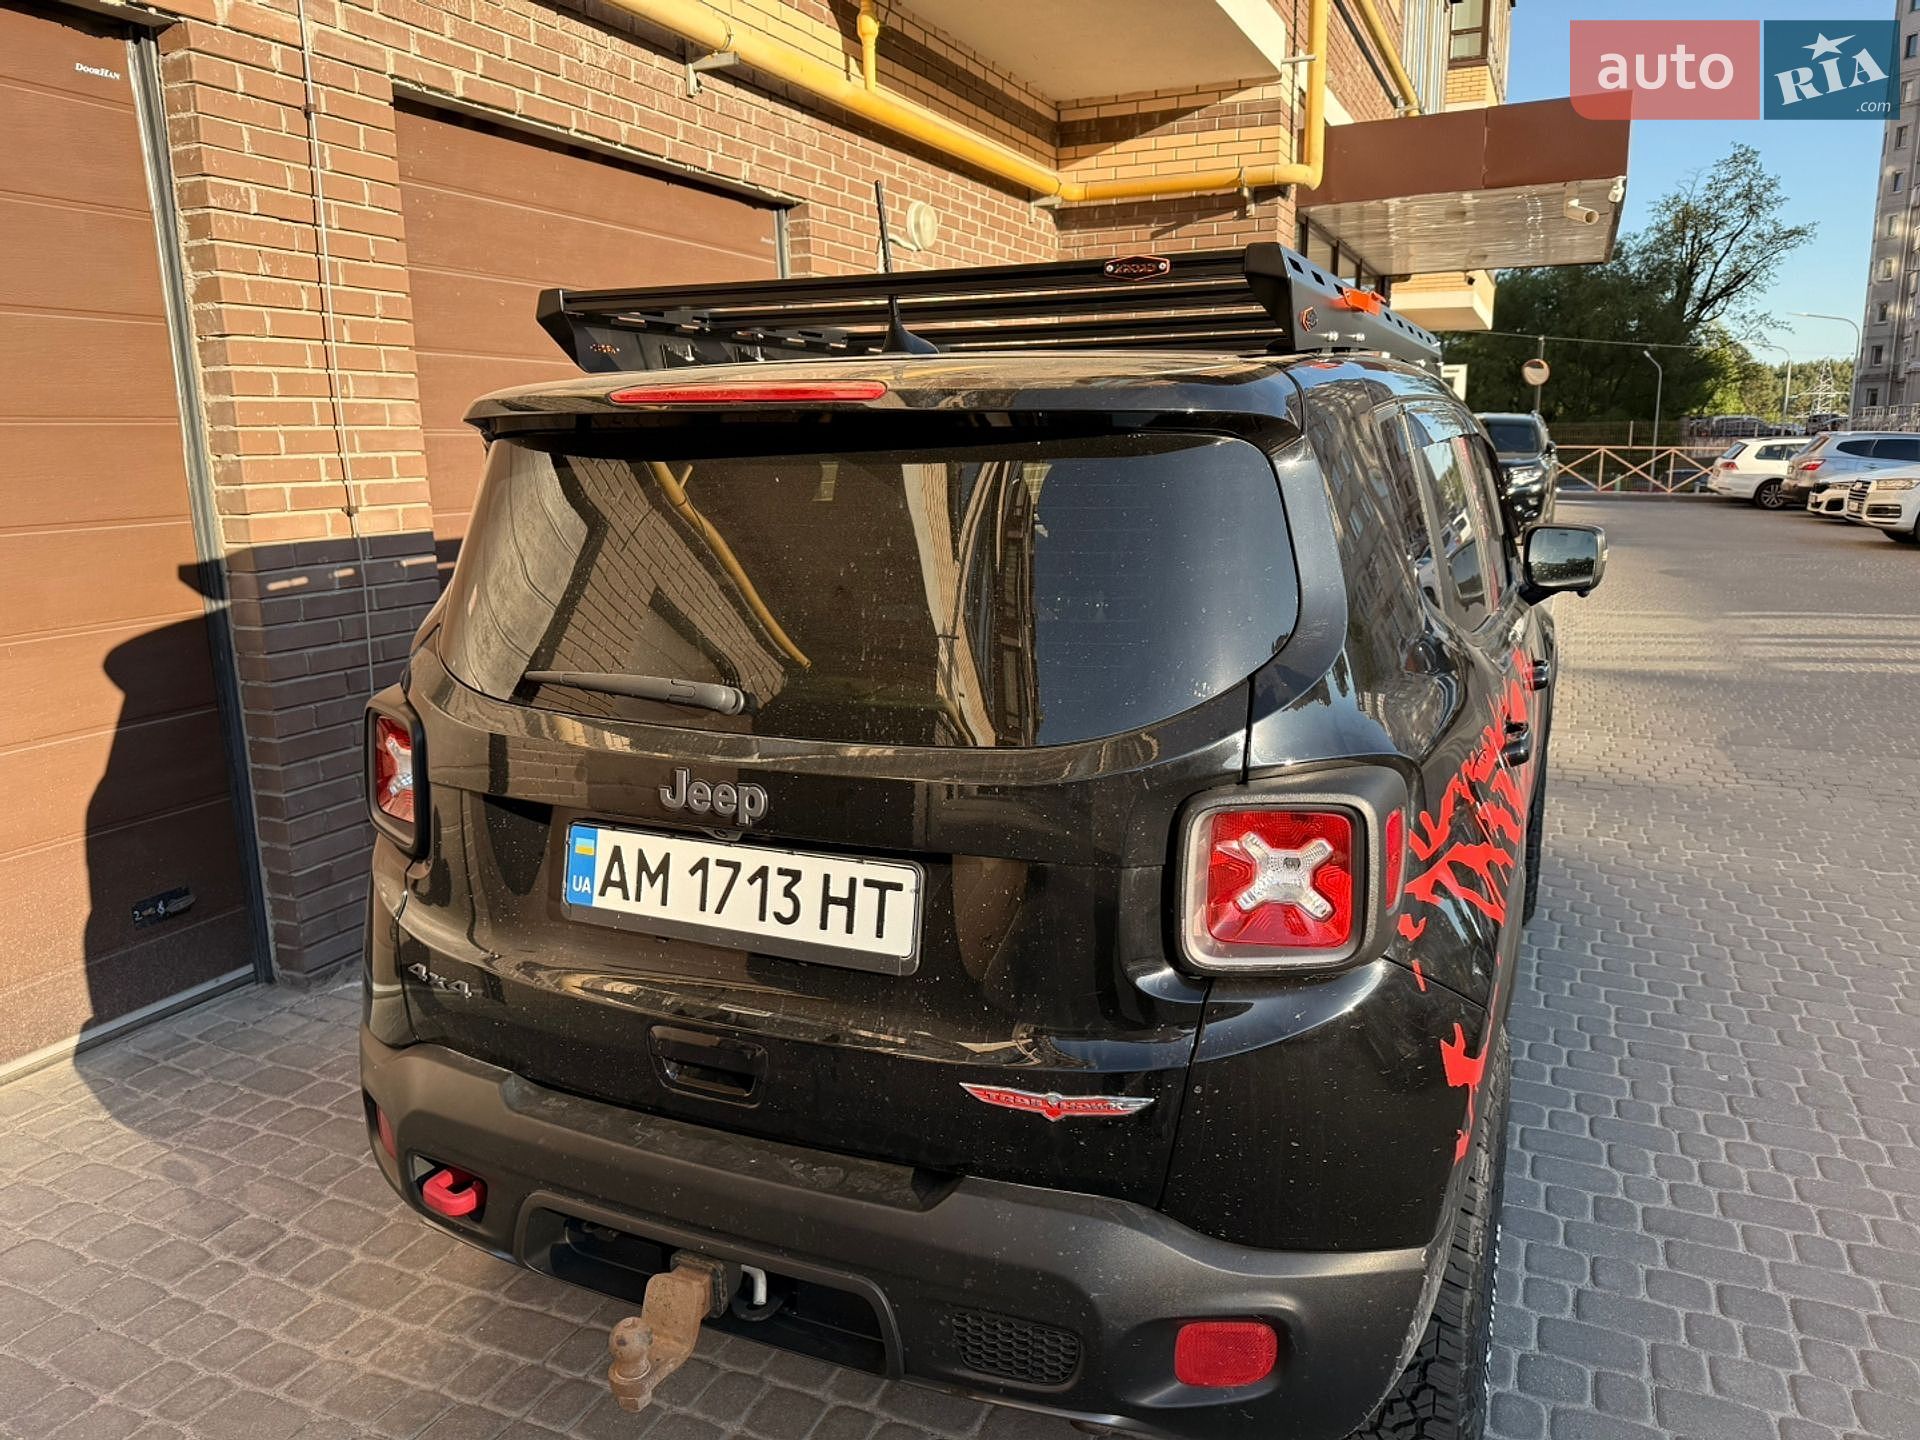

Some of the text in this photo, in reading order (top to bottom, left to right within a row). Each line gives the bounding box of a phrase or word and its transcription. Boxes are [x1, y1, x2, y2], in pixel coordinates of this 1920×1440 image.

[659, 768, 769, 826] Jeep
[573, 875, 592, 894] UA
[598, 845, 904, 939] AM 1713 HT
